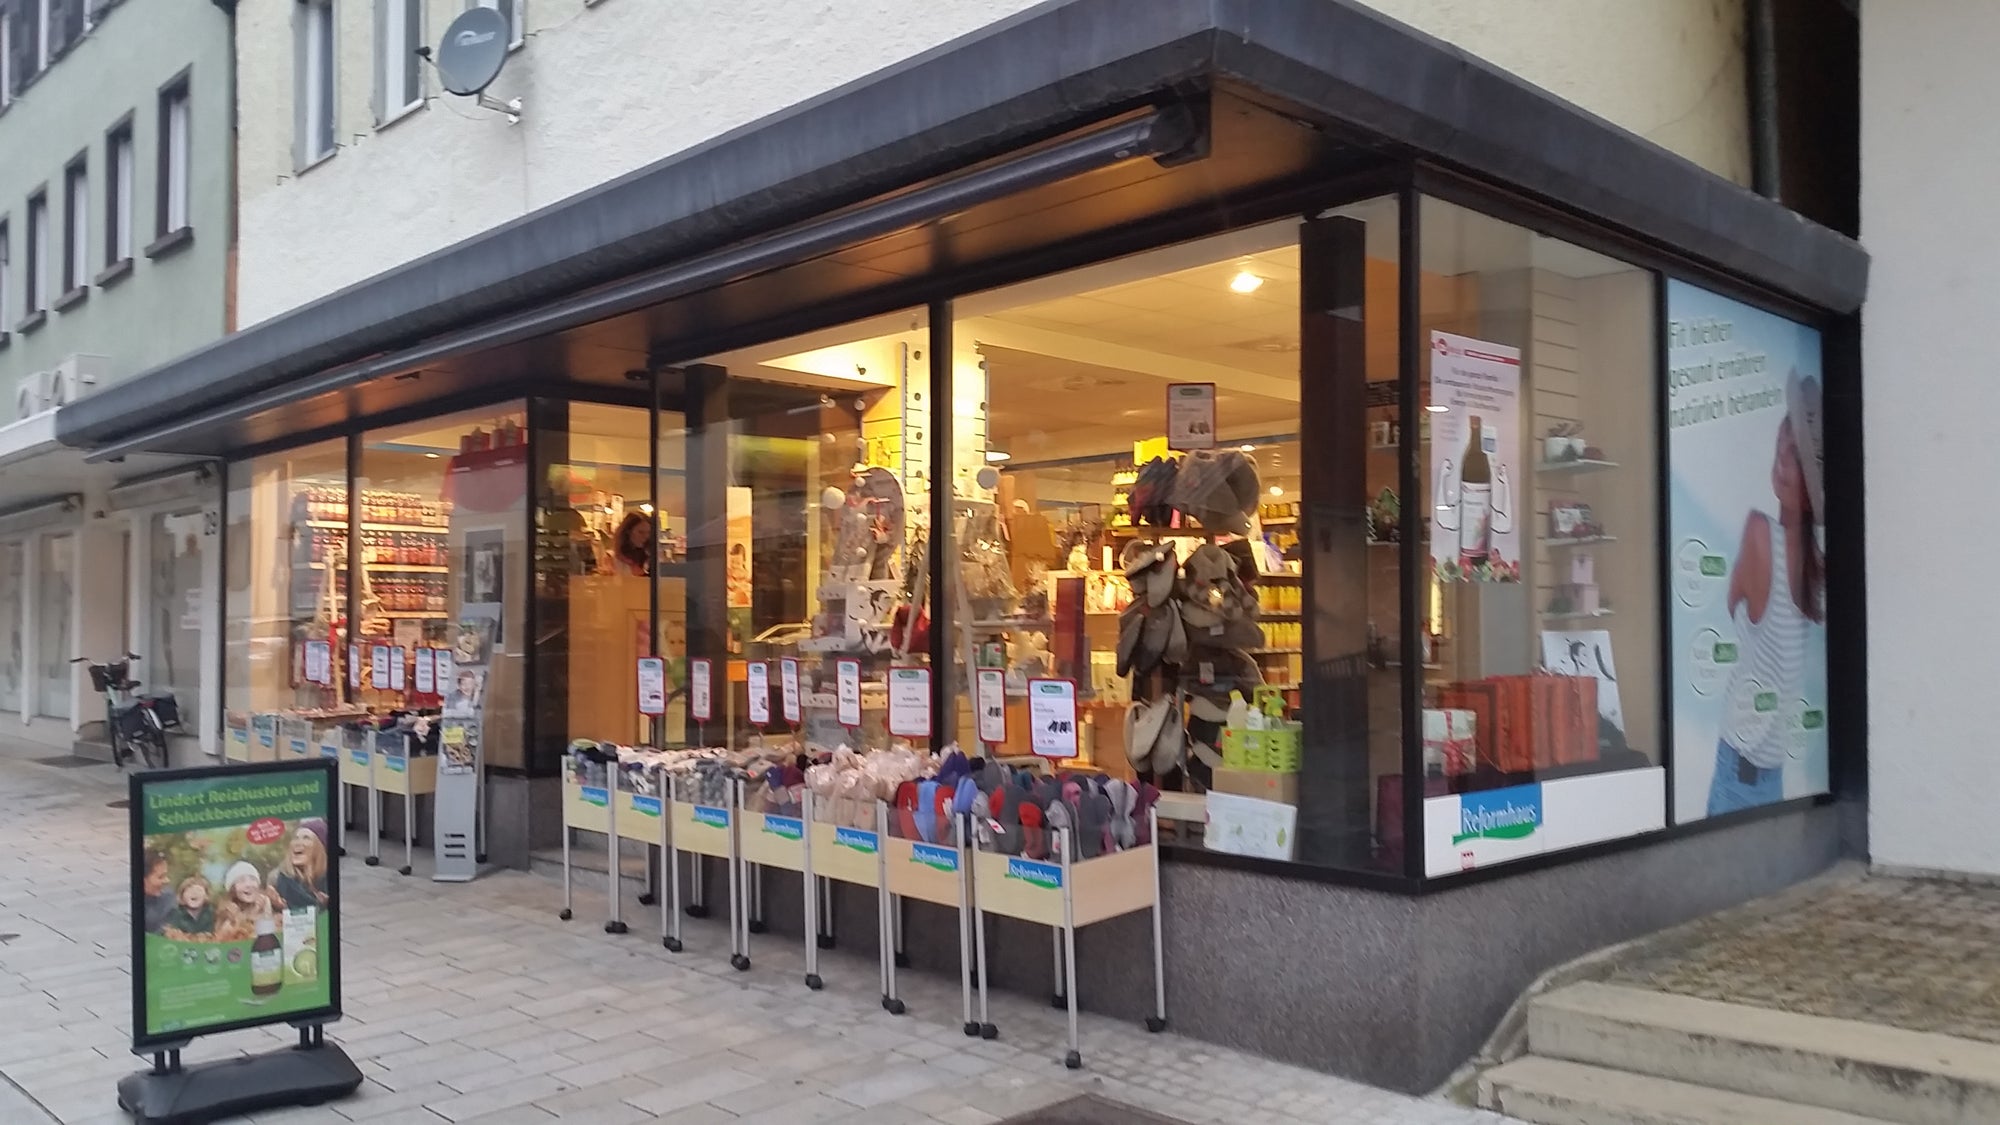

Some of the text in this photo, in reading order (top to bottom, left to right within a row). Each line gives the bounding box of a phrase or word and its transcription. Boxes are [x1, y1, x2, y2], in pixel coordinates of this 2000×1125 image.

[1670, 357, 1713, 397] gesund
[151, 780, 320, 810] Lindert Reizhusten und
[158, 800, 312, 827] Schluckbeschwerden
[1462, 801, 1537, 838] Reformhaus
